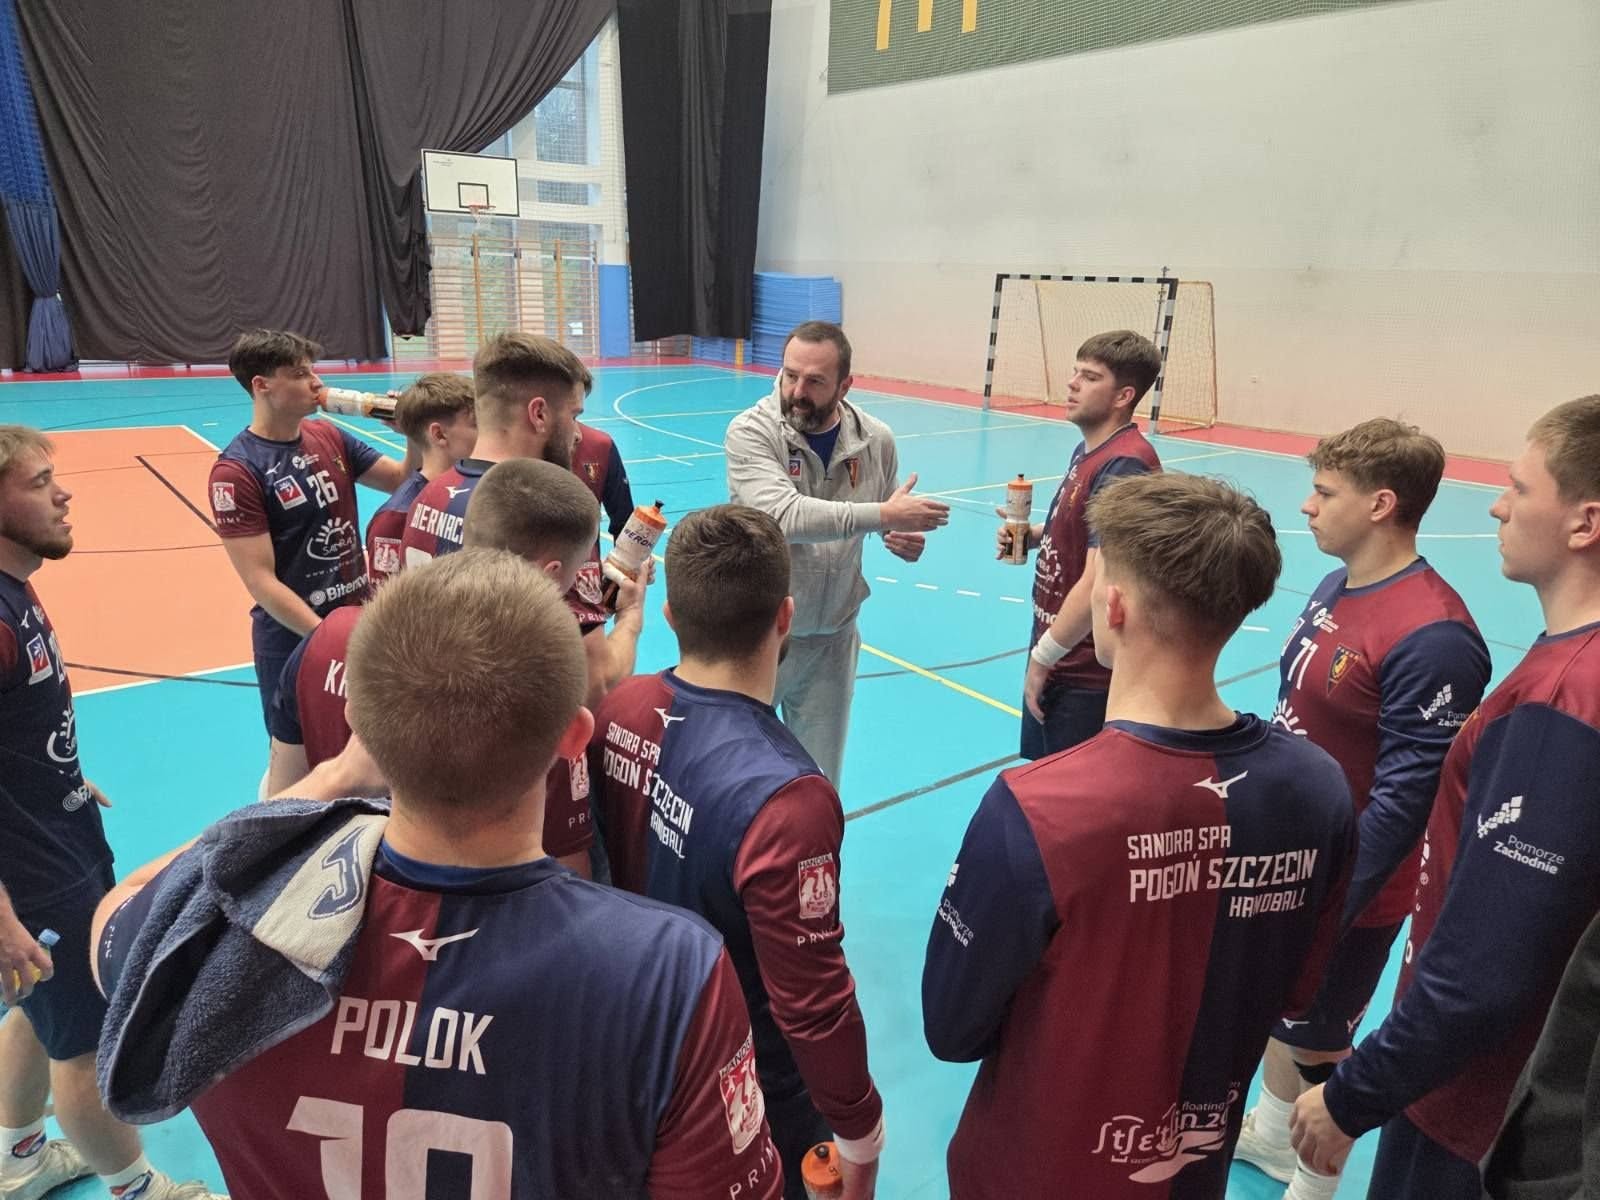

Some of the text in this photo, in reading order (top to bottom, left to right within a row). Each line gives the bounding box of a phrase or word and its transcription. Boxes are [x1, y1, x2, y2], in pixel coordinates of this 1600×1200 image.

[306, 470, 339, 509] 26
[606, 721, 662, 766] SANDRA SPA
[642, 768, 694, 836] SZCZECIN
[1127, 825, 1231, 860] SANDRA SPA
[1493, 841, 1559, 875] Zachodnie
[1507, 834, 1566, 865] Pomorze
[1129, 849, 1319, 903] POGOŃ SZCZECIN
[1228, 888, 1306, 918] HANDBALL
[330, 996, 494, 1075] POLOK
